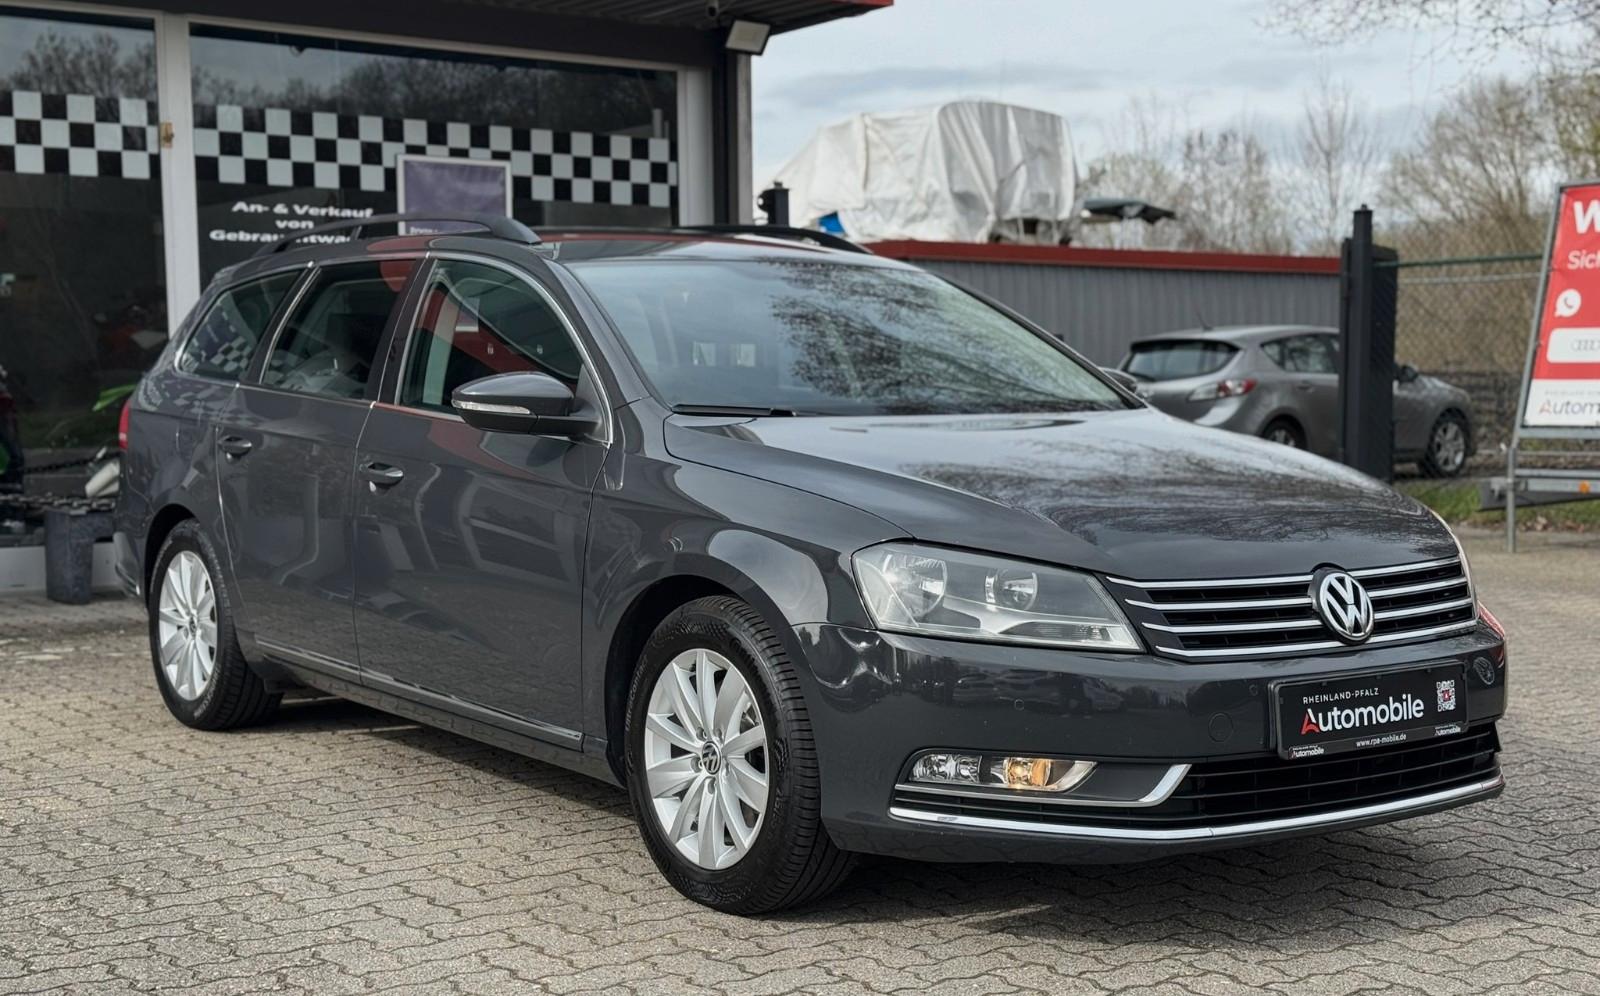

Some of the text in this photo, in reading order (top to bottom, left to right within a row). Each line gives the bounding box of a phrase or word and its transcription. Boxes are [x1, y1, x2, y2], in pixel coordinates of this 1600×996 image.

[232, 201, 373, 218] An- & Verkauf
[275, 219, 314, 229] von
[1302, 687, 1380, 704] RHEINLAND-PFALZ
[1301, 693, 1425, 735] Automobile
